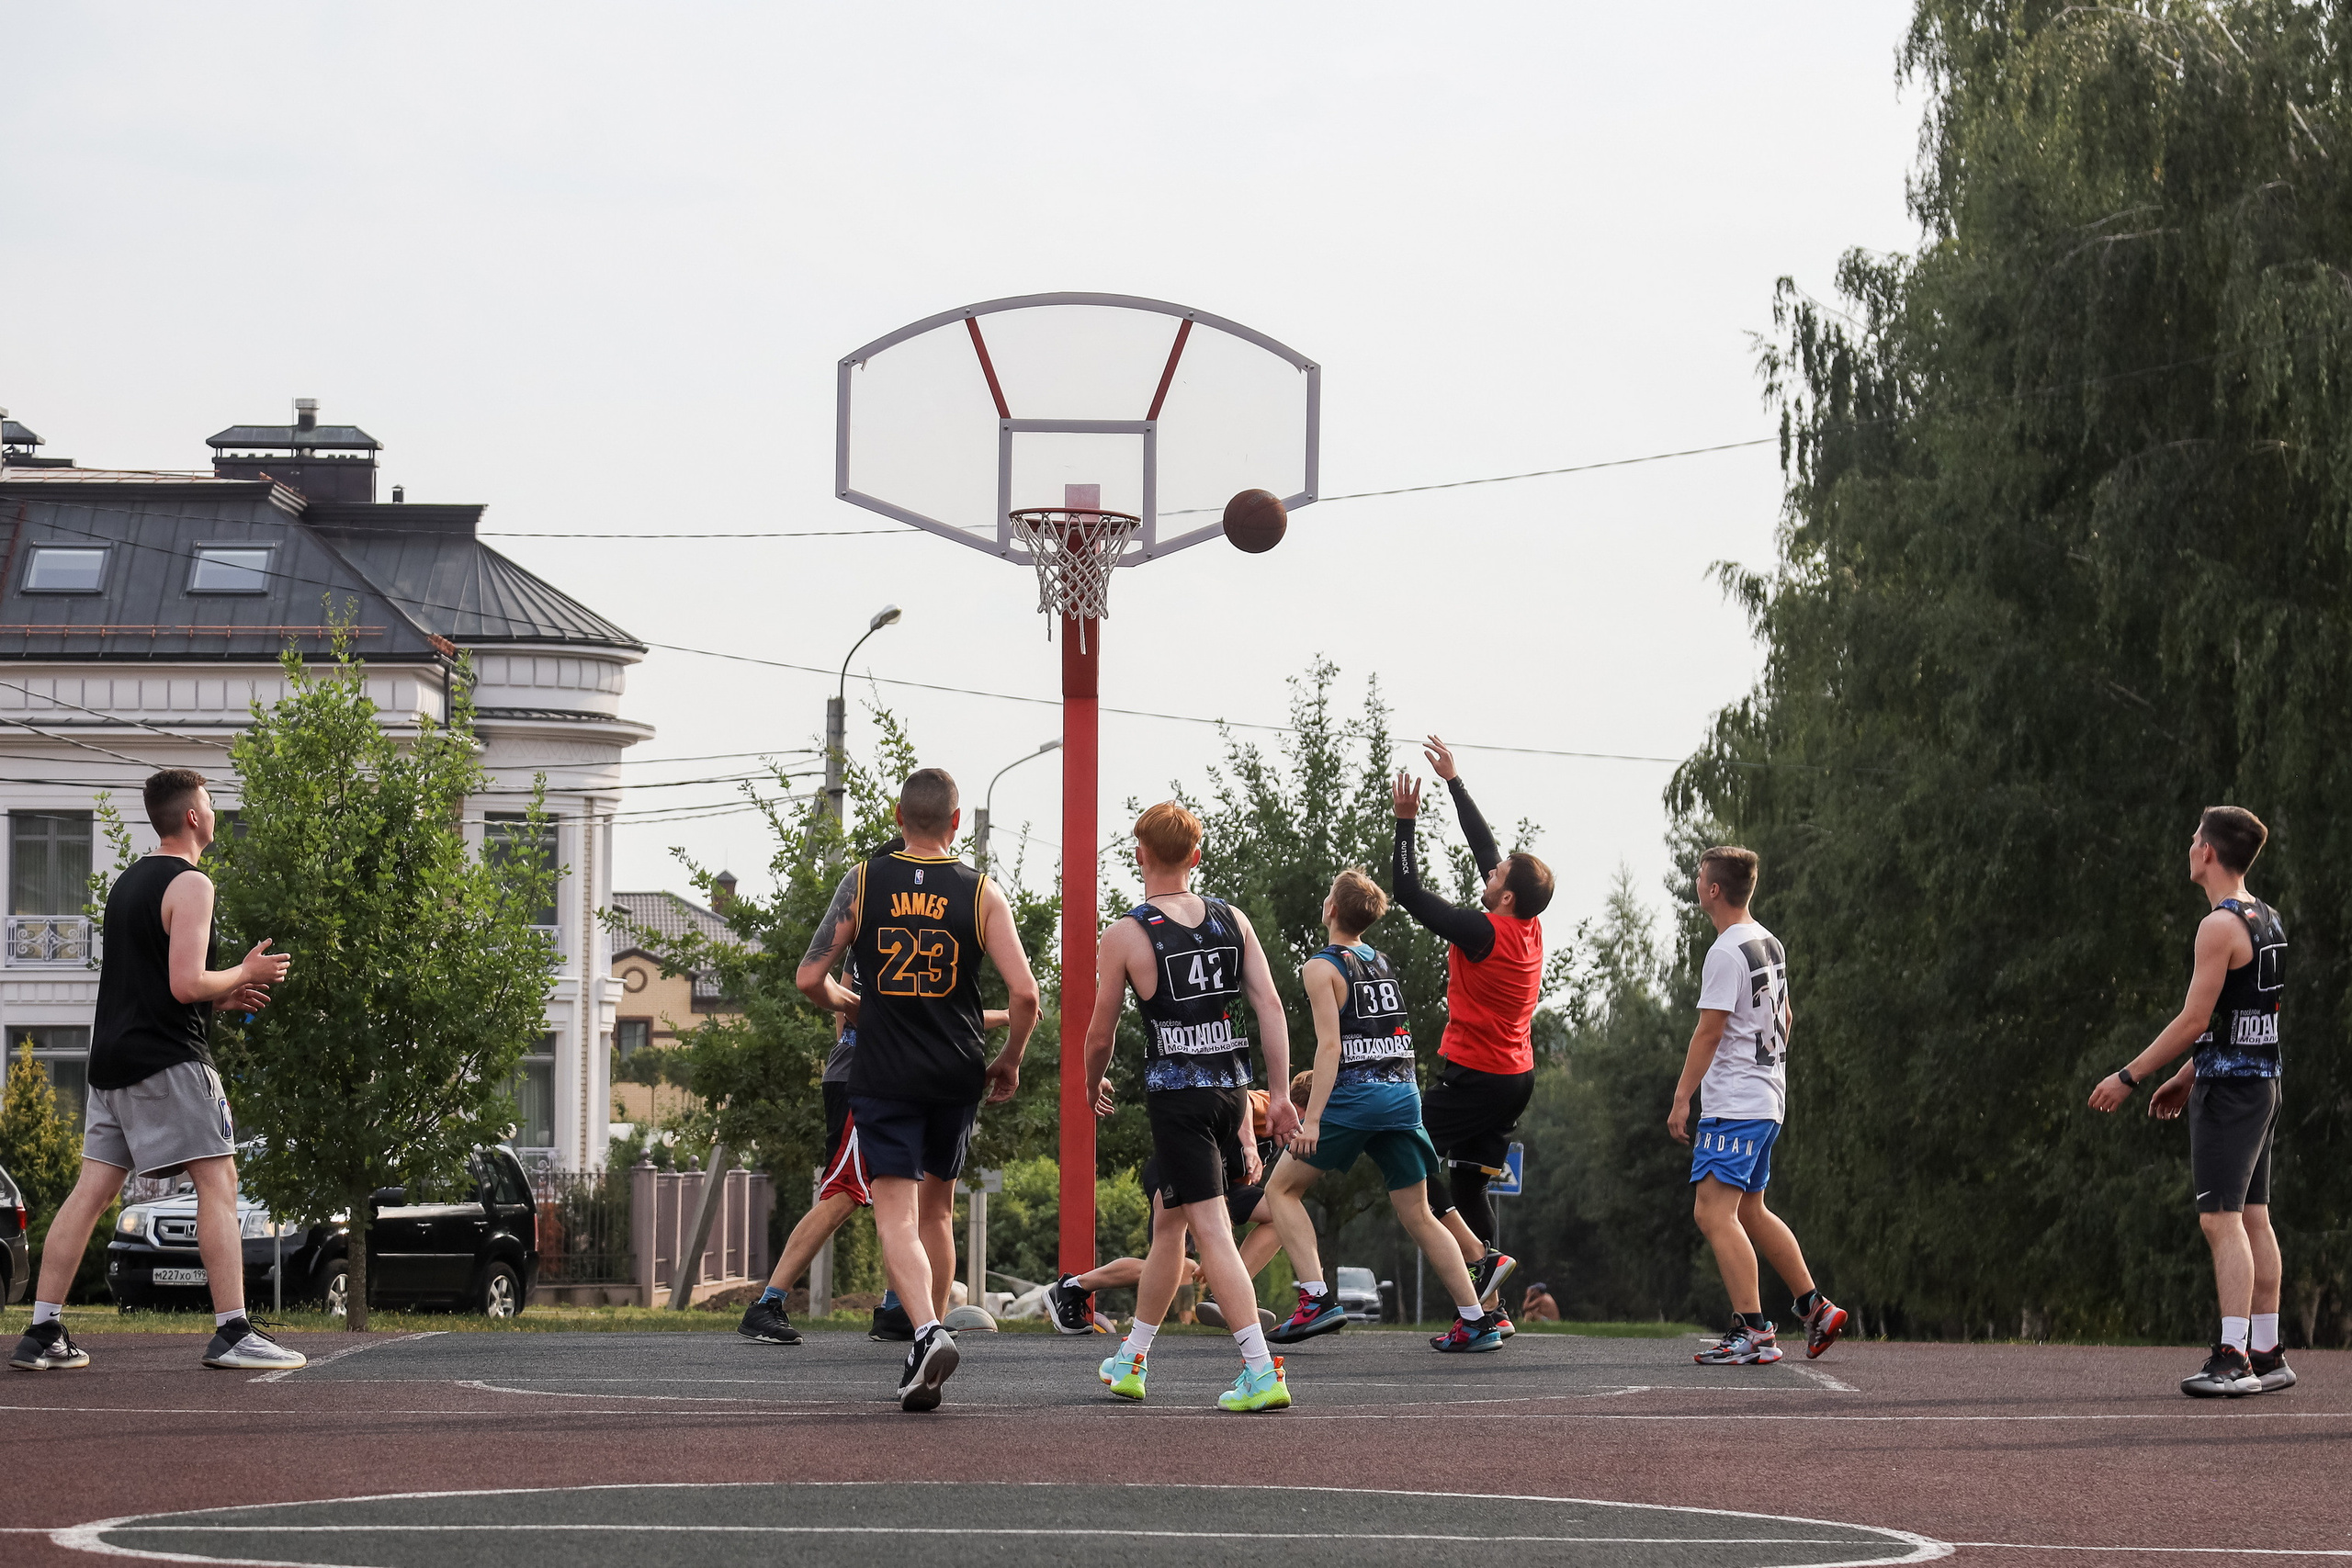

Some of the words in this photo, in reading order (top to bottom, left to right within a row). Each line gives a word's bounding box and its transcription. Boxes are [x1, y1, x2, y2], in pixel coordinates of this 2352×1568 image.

[1401, 840, 1409, 875] OUTSHOCK
[890, 892, 949, 920] JAMES
[877, 927, 959, 998] 23
[1188, 952, 1224, 991] 42
[1363, 983, 1399, 1013] 38
[1168, 1044, 1189, 1053] Моя
